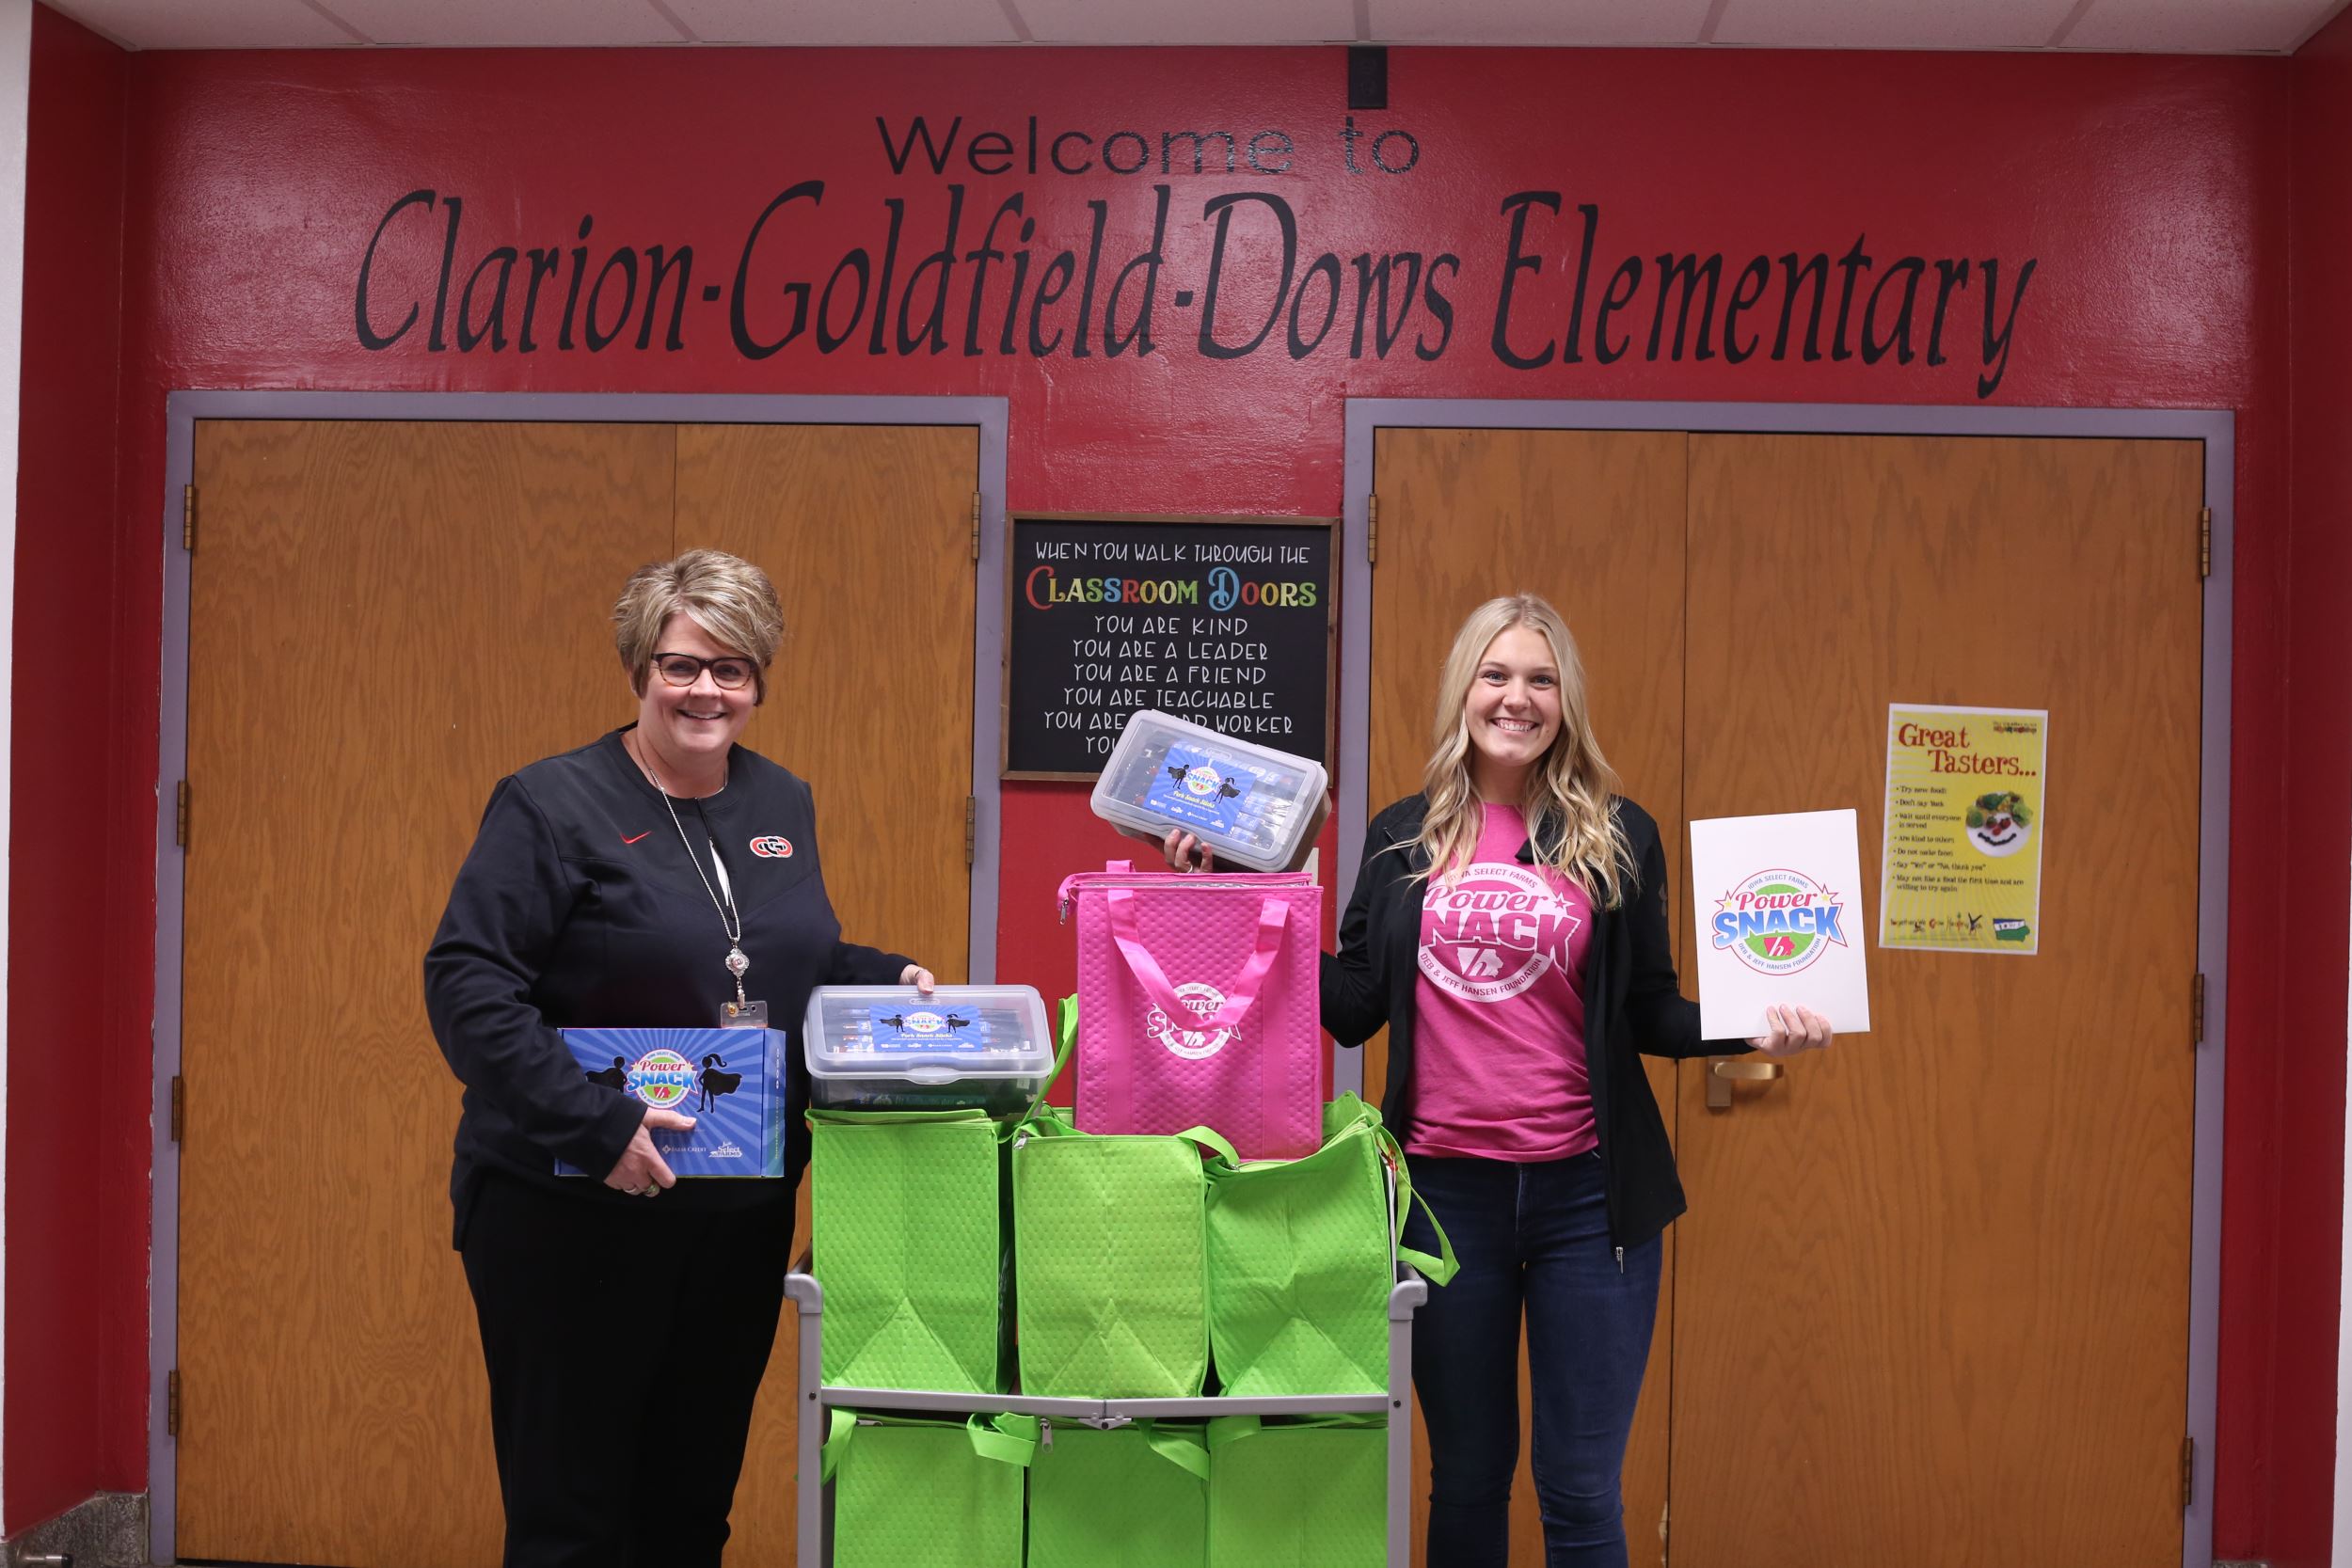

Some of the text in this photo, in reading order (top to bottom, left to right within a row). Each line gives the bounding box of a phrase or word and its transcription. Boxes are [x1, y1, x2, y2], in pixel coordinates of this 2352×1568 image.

[876, 115, 1419, 175] Welcome to
[356, 180, 2037, 399] Clarion-Goldfield-Dows Elementary
[1036, 541, 1311, 564] WHEN YOU WALK THROUGH THE
[1025, 565, 1317, 611] CLASSROOM DOORS
[1094, 615, 1248, 636] YOU ARE KIND
[1073, 639, 1268, 660] YOU ARE A LEADER
[1073, 663, 1266, 685] YOU ARE A FRIEND
[1063, 688, 1275, 709] YOU ARE TEACHABLE
[1044, 711, 1082, 730] YOU
[1089, 712, 1126, 730] ARE
[1216, 715, 1293, 734] WORKER
[1898, 722, 1970, 749] Great
[1928, 750, 2037, 777] Tasters...
[1900, 785, 1912, 794] Try
[1474, 867, 1537, 888] SELECT FARMS
[1748, 878, 1763, 890] IOWA
[1788, 875, 1808, 889] FARMS
[1425, 884, 1549, 911] Power
[1735, 892, 1818, 911] Power
[1715, 906, 1842, 947] SNACK
[1421, 910, 1577, 972] NACK
[1792, 937, 1821, 967] FOUNDATION
[1420, 953, 1435, 970] DEB
[1442, 975, 1460, 988] JEFF
[1461, 984, 1498, 996] HANSEN
[1500, 958, 1542, 992] FOUNDATION
[1183, 1001, 1223, 1012] wer
[640, 1059, 685, 1071] Power
[628, 1071, 697, 1091] SNACK
